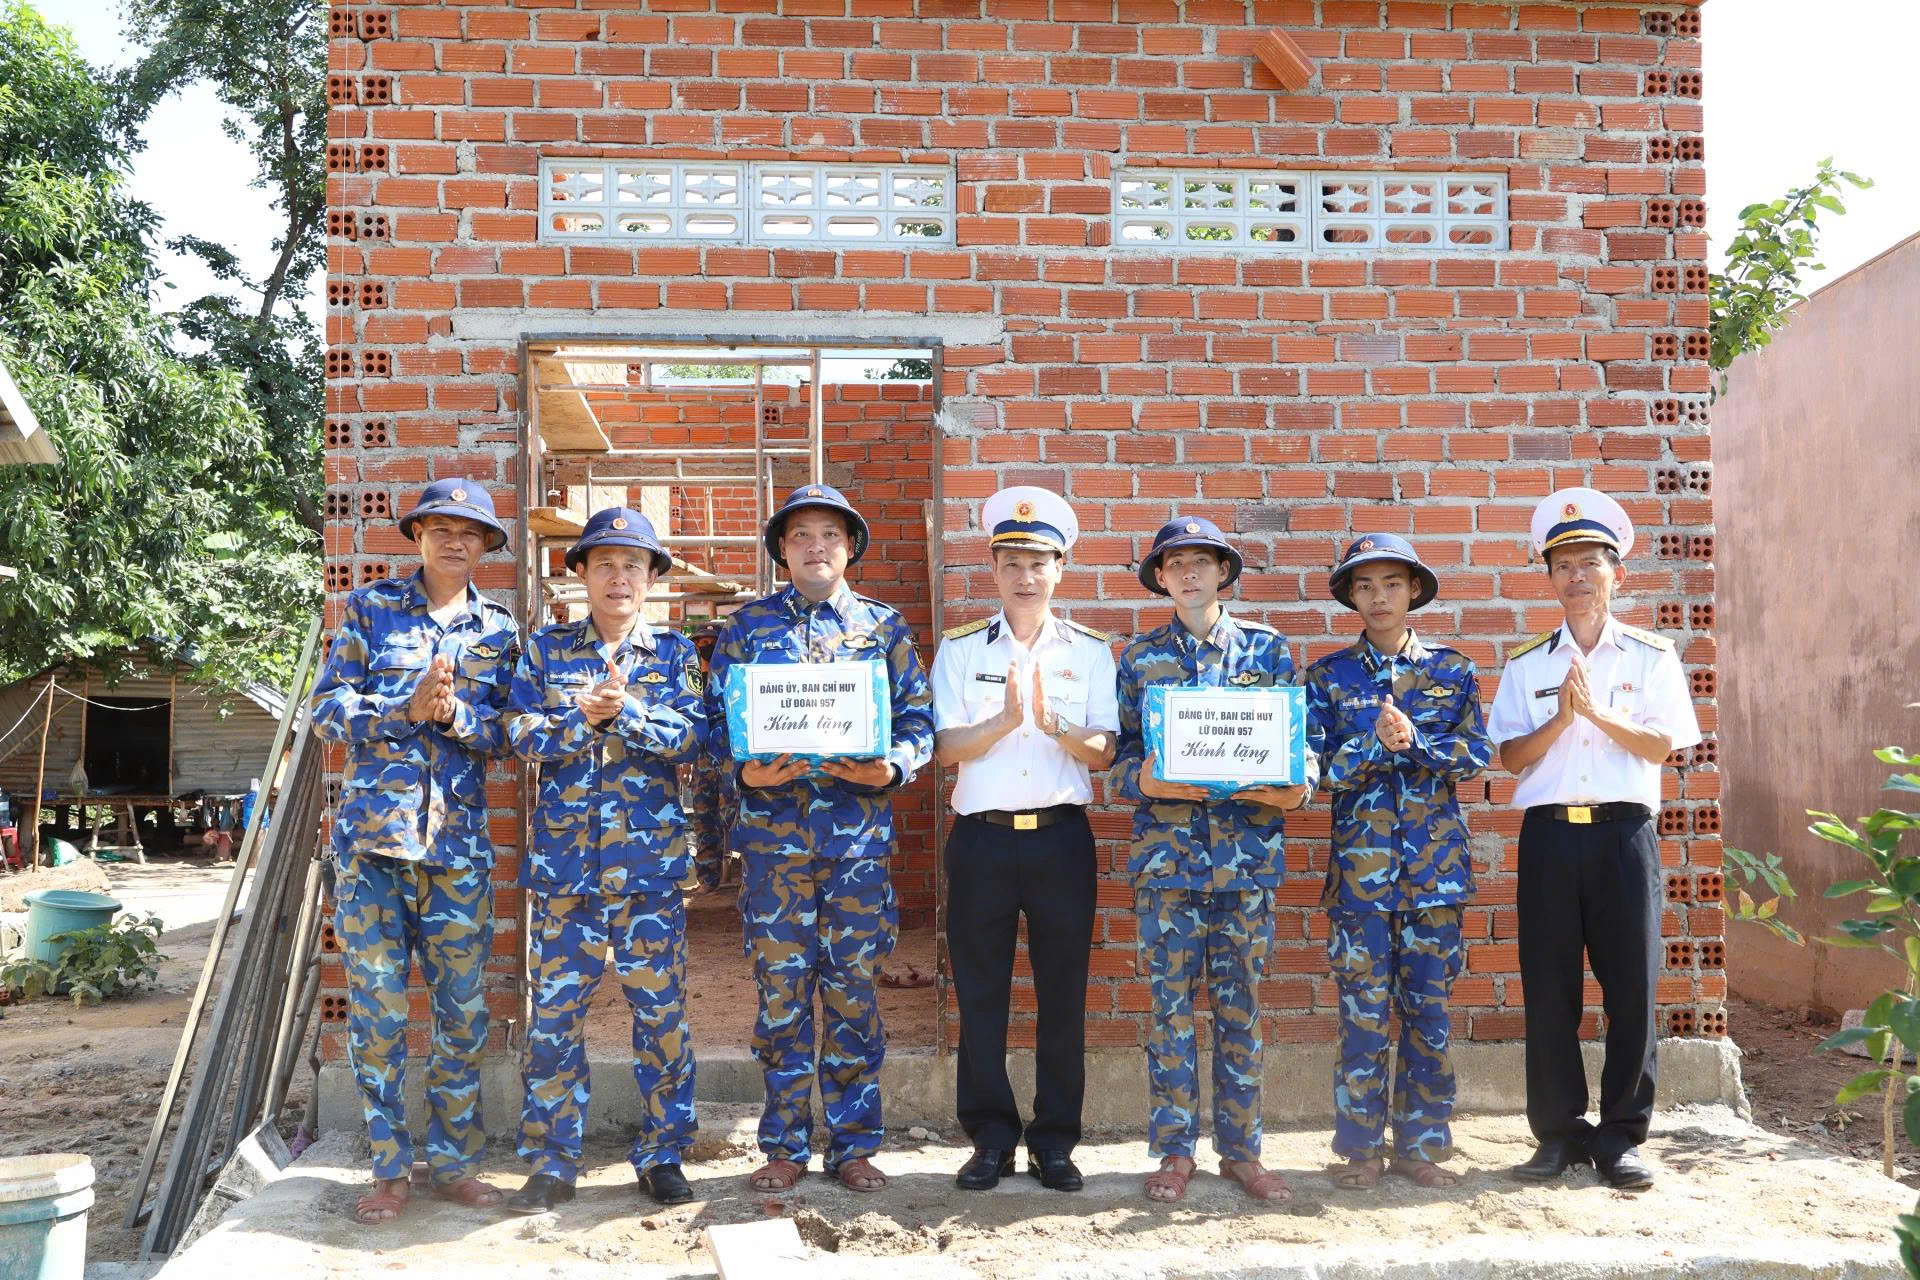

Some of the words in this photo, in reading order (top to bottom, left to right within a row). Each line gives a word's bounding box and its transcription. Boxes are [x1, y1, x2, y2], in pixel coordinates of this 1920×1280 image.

[760, 682, 783, 694] ĐẢNG
[786, 682, 800, 694] ỦY,
[802, 684, 820, 693] BAN
[823, 681, 836, 692] CHỈ
[840, 683, 856, 692] HUY
[781, 698, 792, 708] LỮ
[794, 697, 817, 708] ĐOÀN
[820, 698, 835, 708] 957
[1178, 708, 1202, 720] ĐẢNG
[1204, 708, 1218, 721] ỦY,
[1221, 712, 1238, 720] BAN
[1241, 709, 1254, 720] CHỈ
[1257, 712, 1272, 720] HUY
[764, 714, 809, 731] Kính
[816, 714, 852, 735] tặng
[1199, 725, 1210, 735] LỮ
[1212, 725, 1235, 735] ĐOÀN
[1238, 727, 1252, 736] 957
[1181, 741, 1226, 757] Kính
[1234, 743, 1270, 764] tặng
